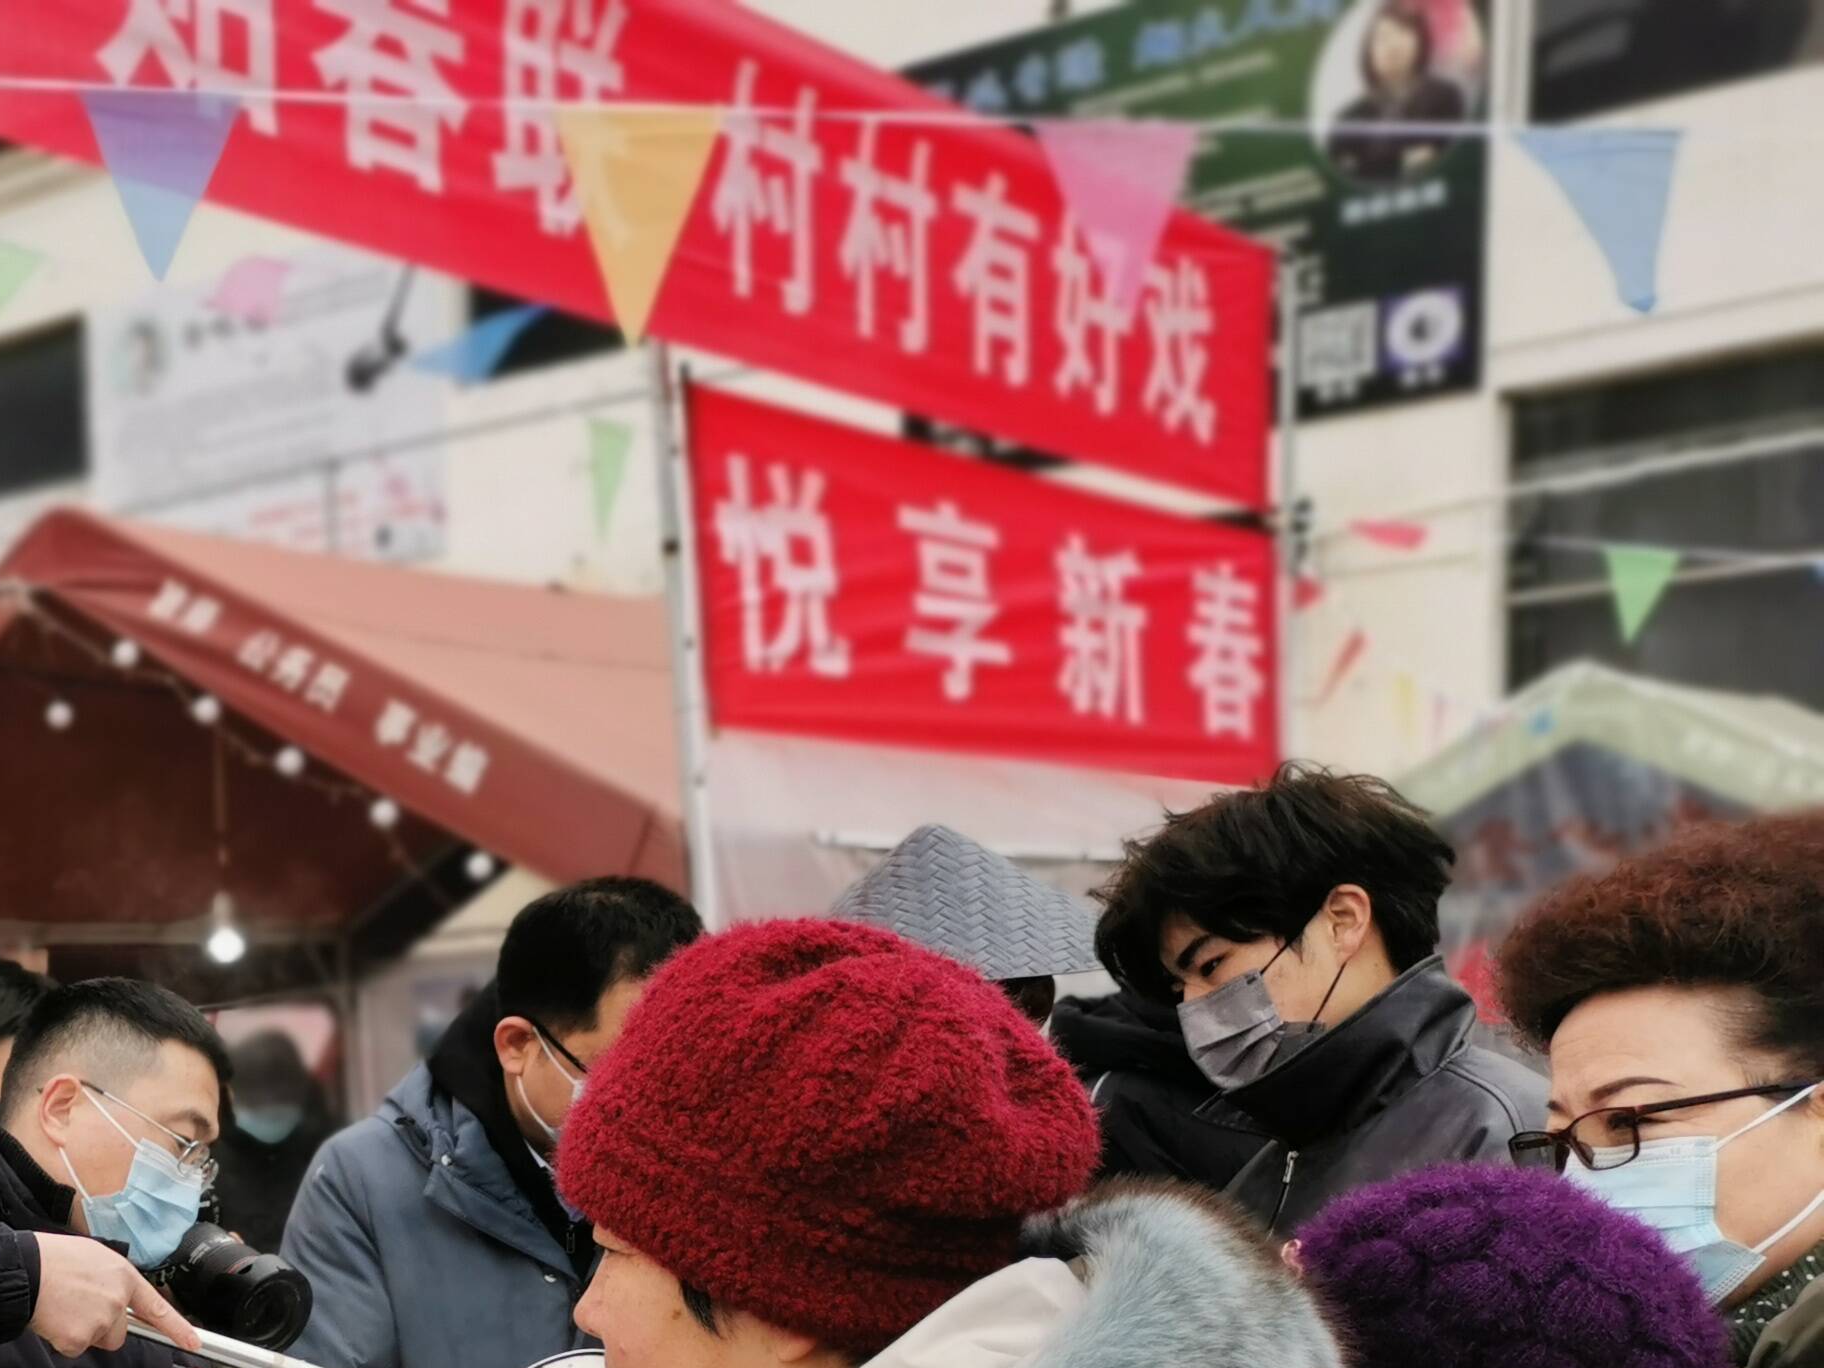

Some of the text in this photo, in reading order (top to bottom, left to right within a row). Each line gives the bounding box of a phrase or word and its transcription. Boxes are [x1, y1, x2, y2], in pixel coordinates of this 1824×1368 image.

[712, 58, 1220, 450] 村村有好戏
[713, 453, 1270, 742] 悦享新春
